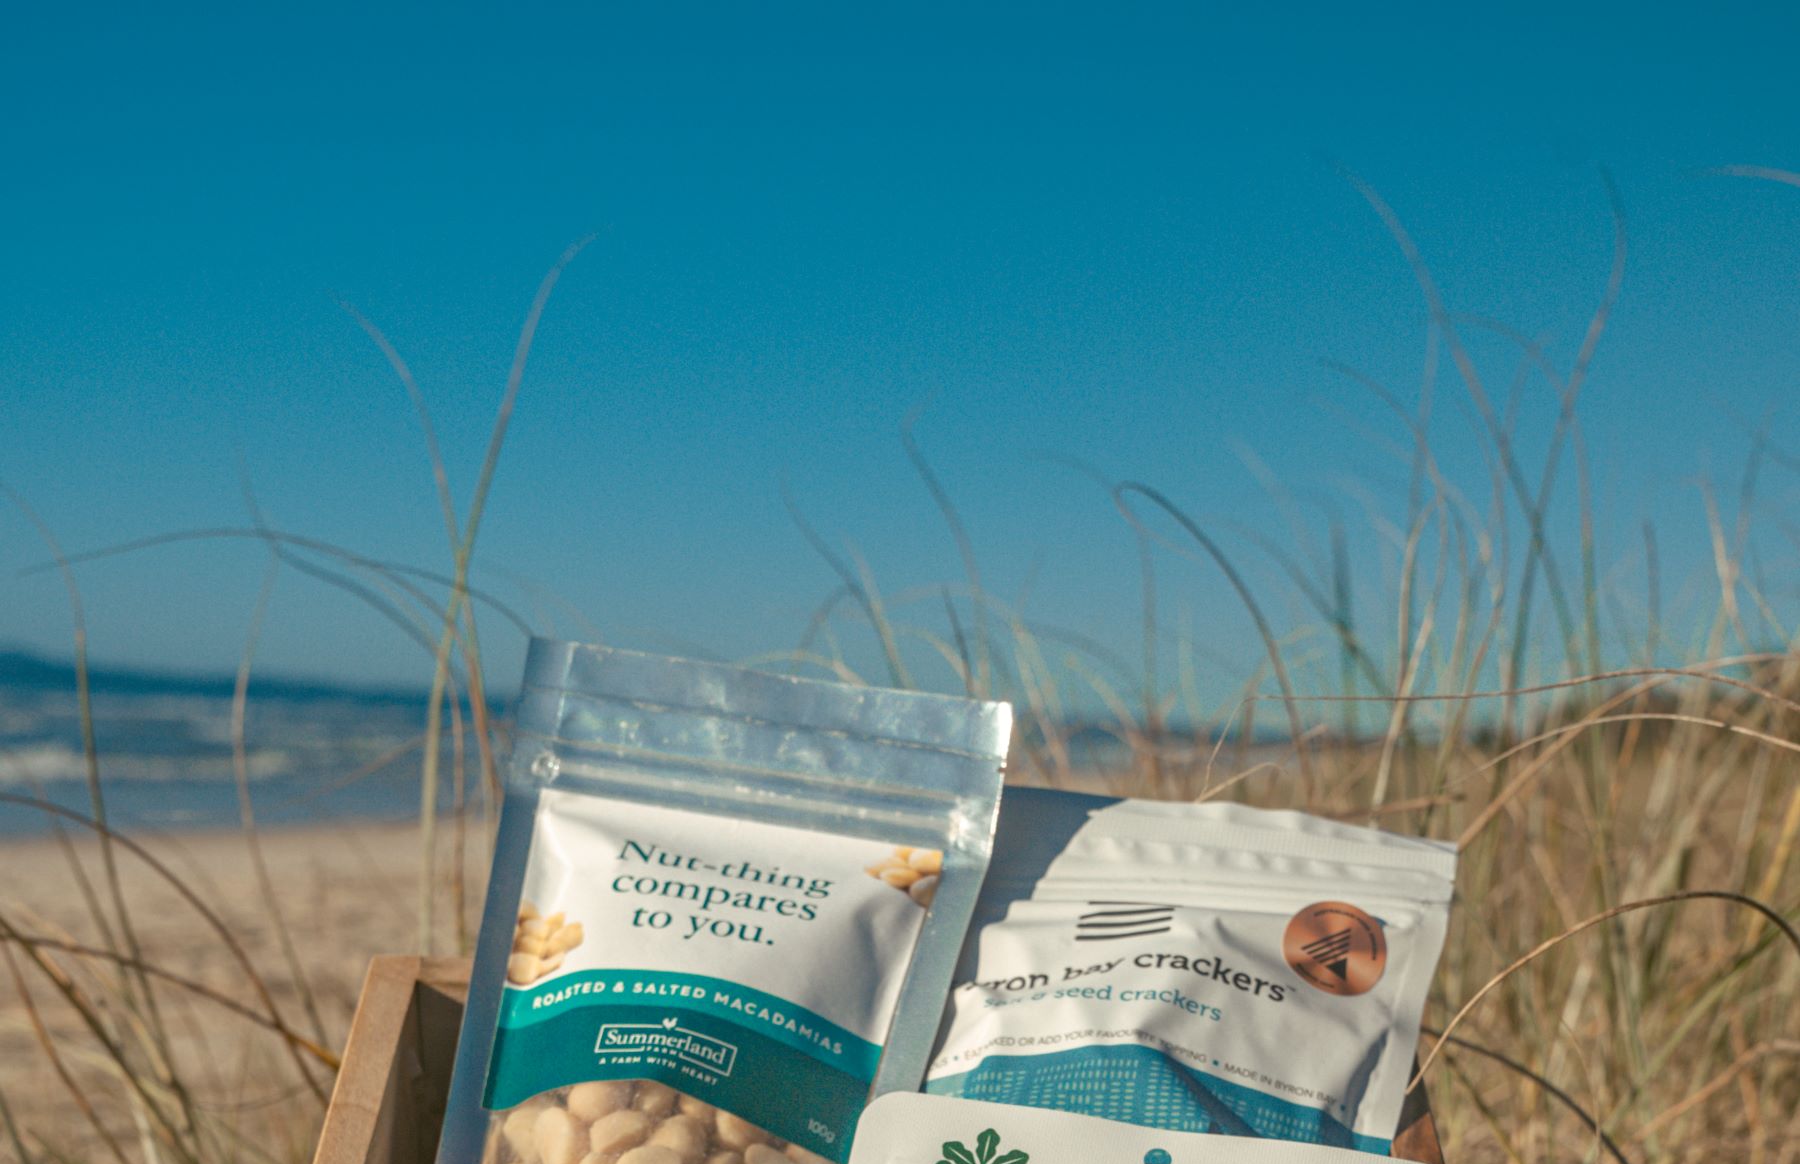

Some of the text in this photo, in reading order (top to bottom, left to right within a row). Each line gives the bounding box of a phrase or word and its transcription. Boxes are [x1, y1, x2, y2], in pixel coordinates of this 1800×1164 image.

[617, 839, 835, 899] Nut-thing
[611, 874, 818, 921] compares
[632, 908, 774, 946] to you.
[1063, 957, 1126, 981] bay
[533, 981, 844, 1056] ROASTED & SALTED MACADAMIAS
[1053, 985, 1113, 1001] seed
[1120, 988, 1222, 1022] crackers
[604, 1028, 728, 1065] Summerland
[1064, 1029, 1095, 1041] YOUR
[599, 1055, 718, 1086] A FARM WITH HEART
[1224, 1062, 1258, 1081] MADE
[1260, 1074, 1273, 1086] IN
[1274, 1079, 1315, 1099] BYRON
[807, 1117, 836, 1144] 100g
